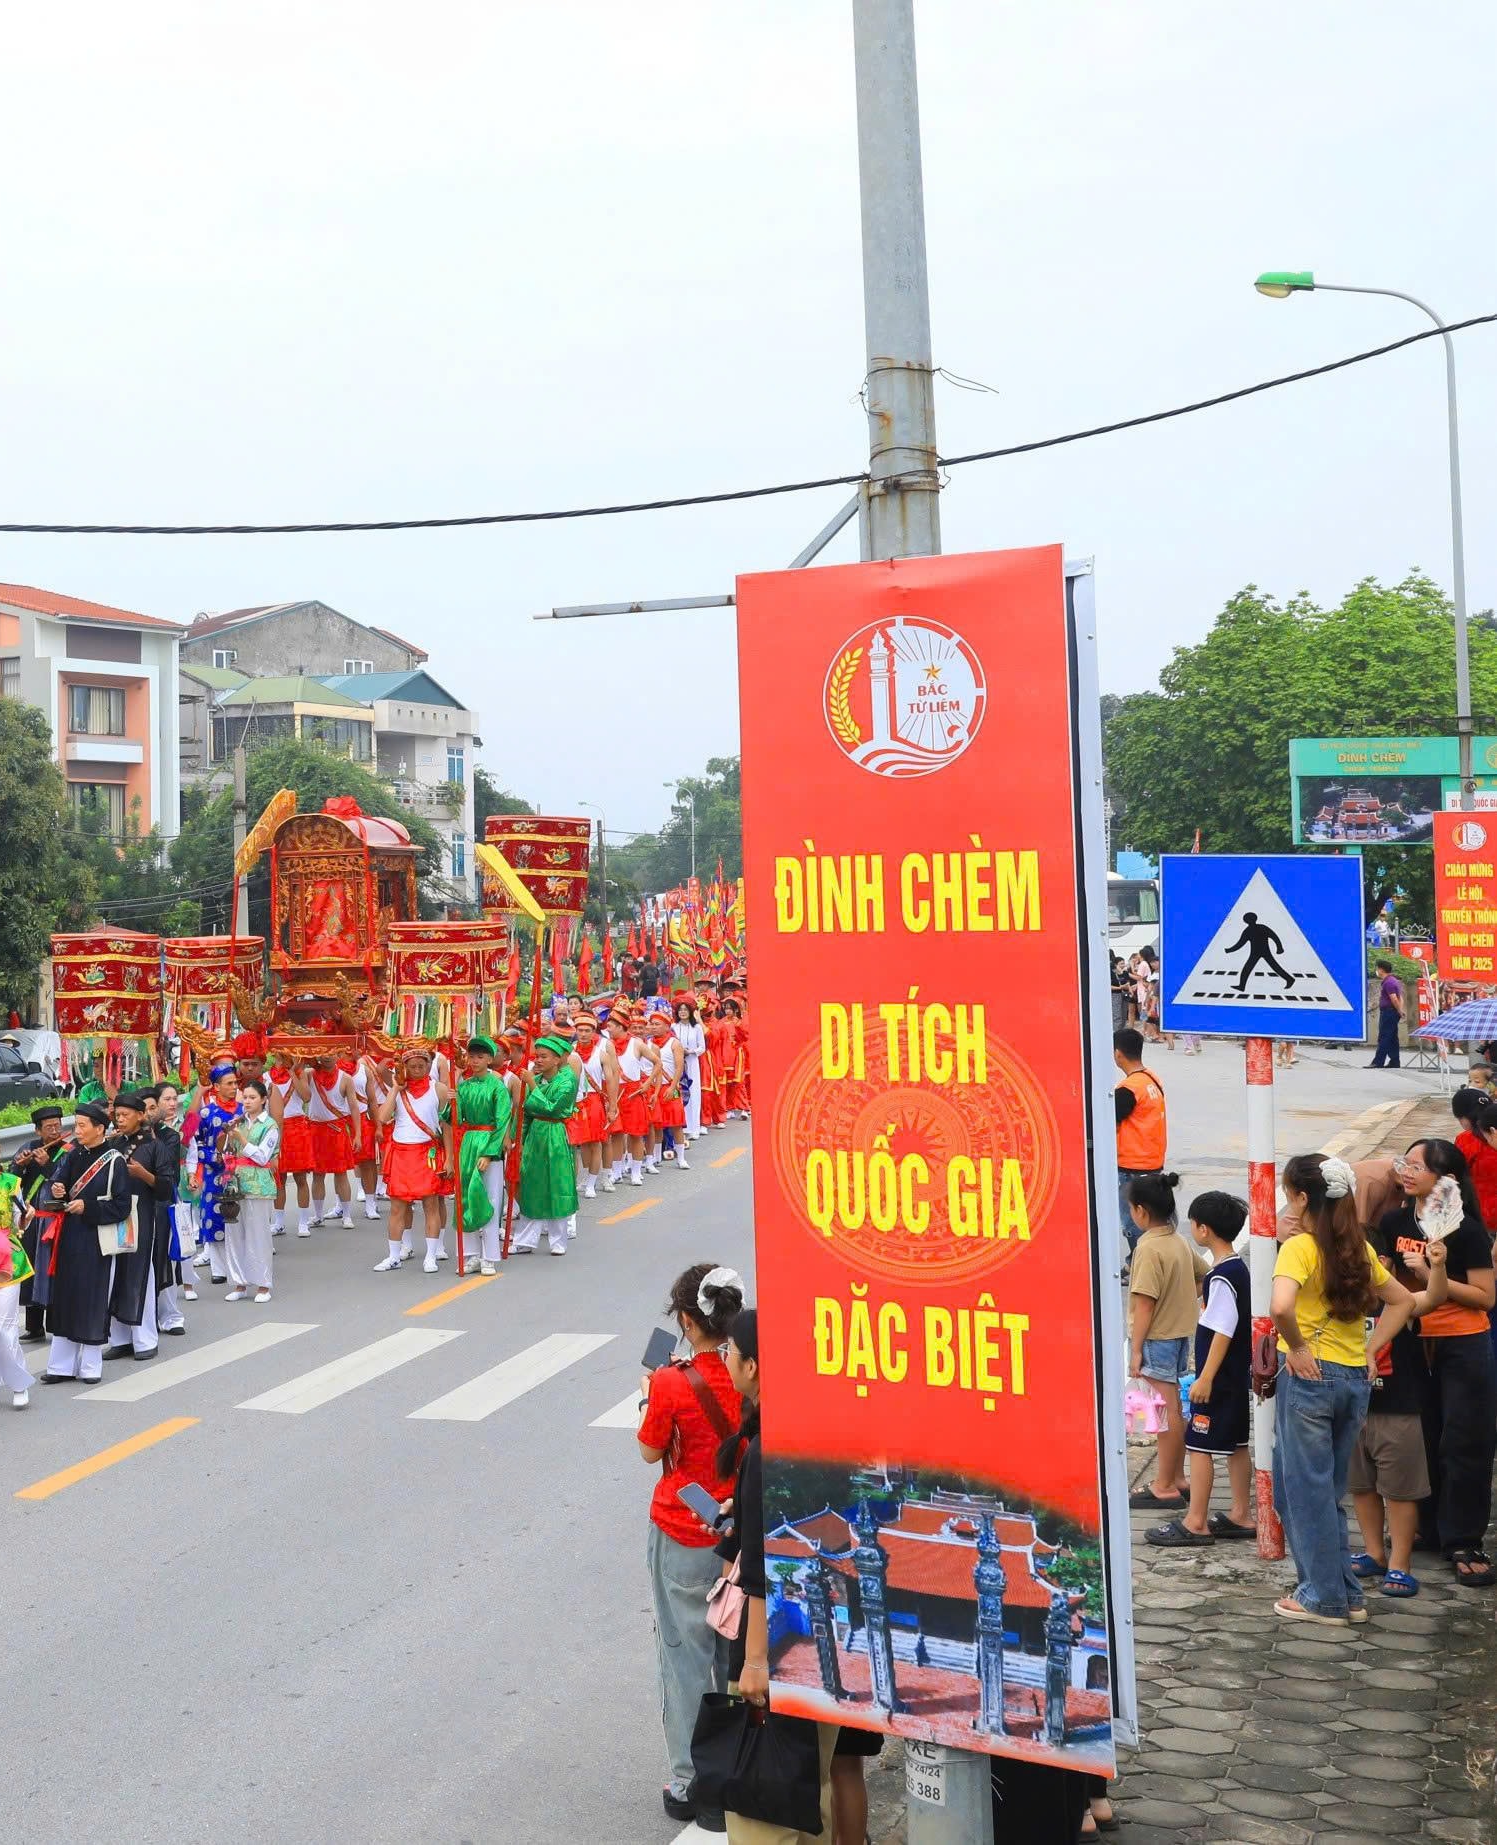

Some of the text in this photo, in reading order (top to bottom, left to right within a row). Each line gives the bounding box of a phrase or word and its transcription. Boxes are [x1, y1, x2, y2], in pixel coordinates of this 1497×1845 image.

[918, 680, 948, 697] BẮC
[907, 698, 960, 713] TỪ LIÊM
[1445, 860, 1467, 878] CHÀO
[774, 834, 1041, 933] ĐÌNH CHÈM
[1472, 956, 1493, 971] 2025
[820, 986, 987, 1084] DI TÍCH
[805, 1123, 1031, 1241] QUỐC GIA
[813, 1282, 1030, 1412] ĐẶC BIỆT
[915, 1764, 941, 1779] 24/24
[917, 1782, 941, 1801] 388
